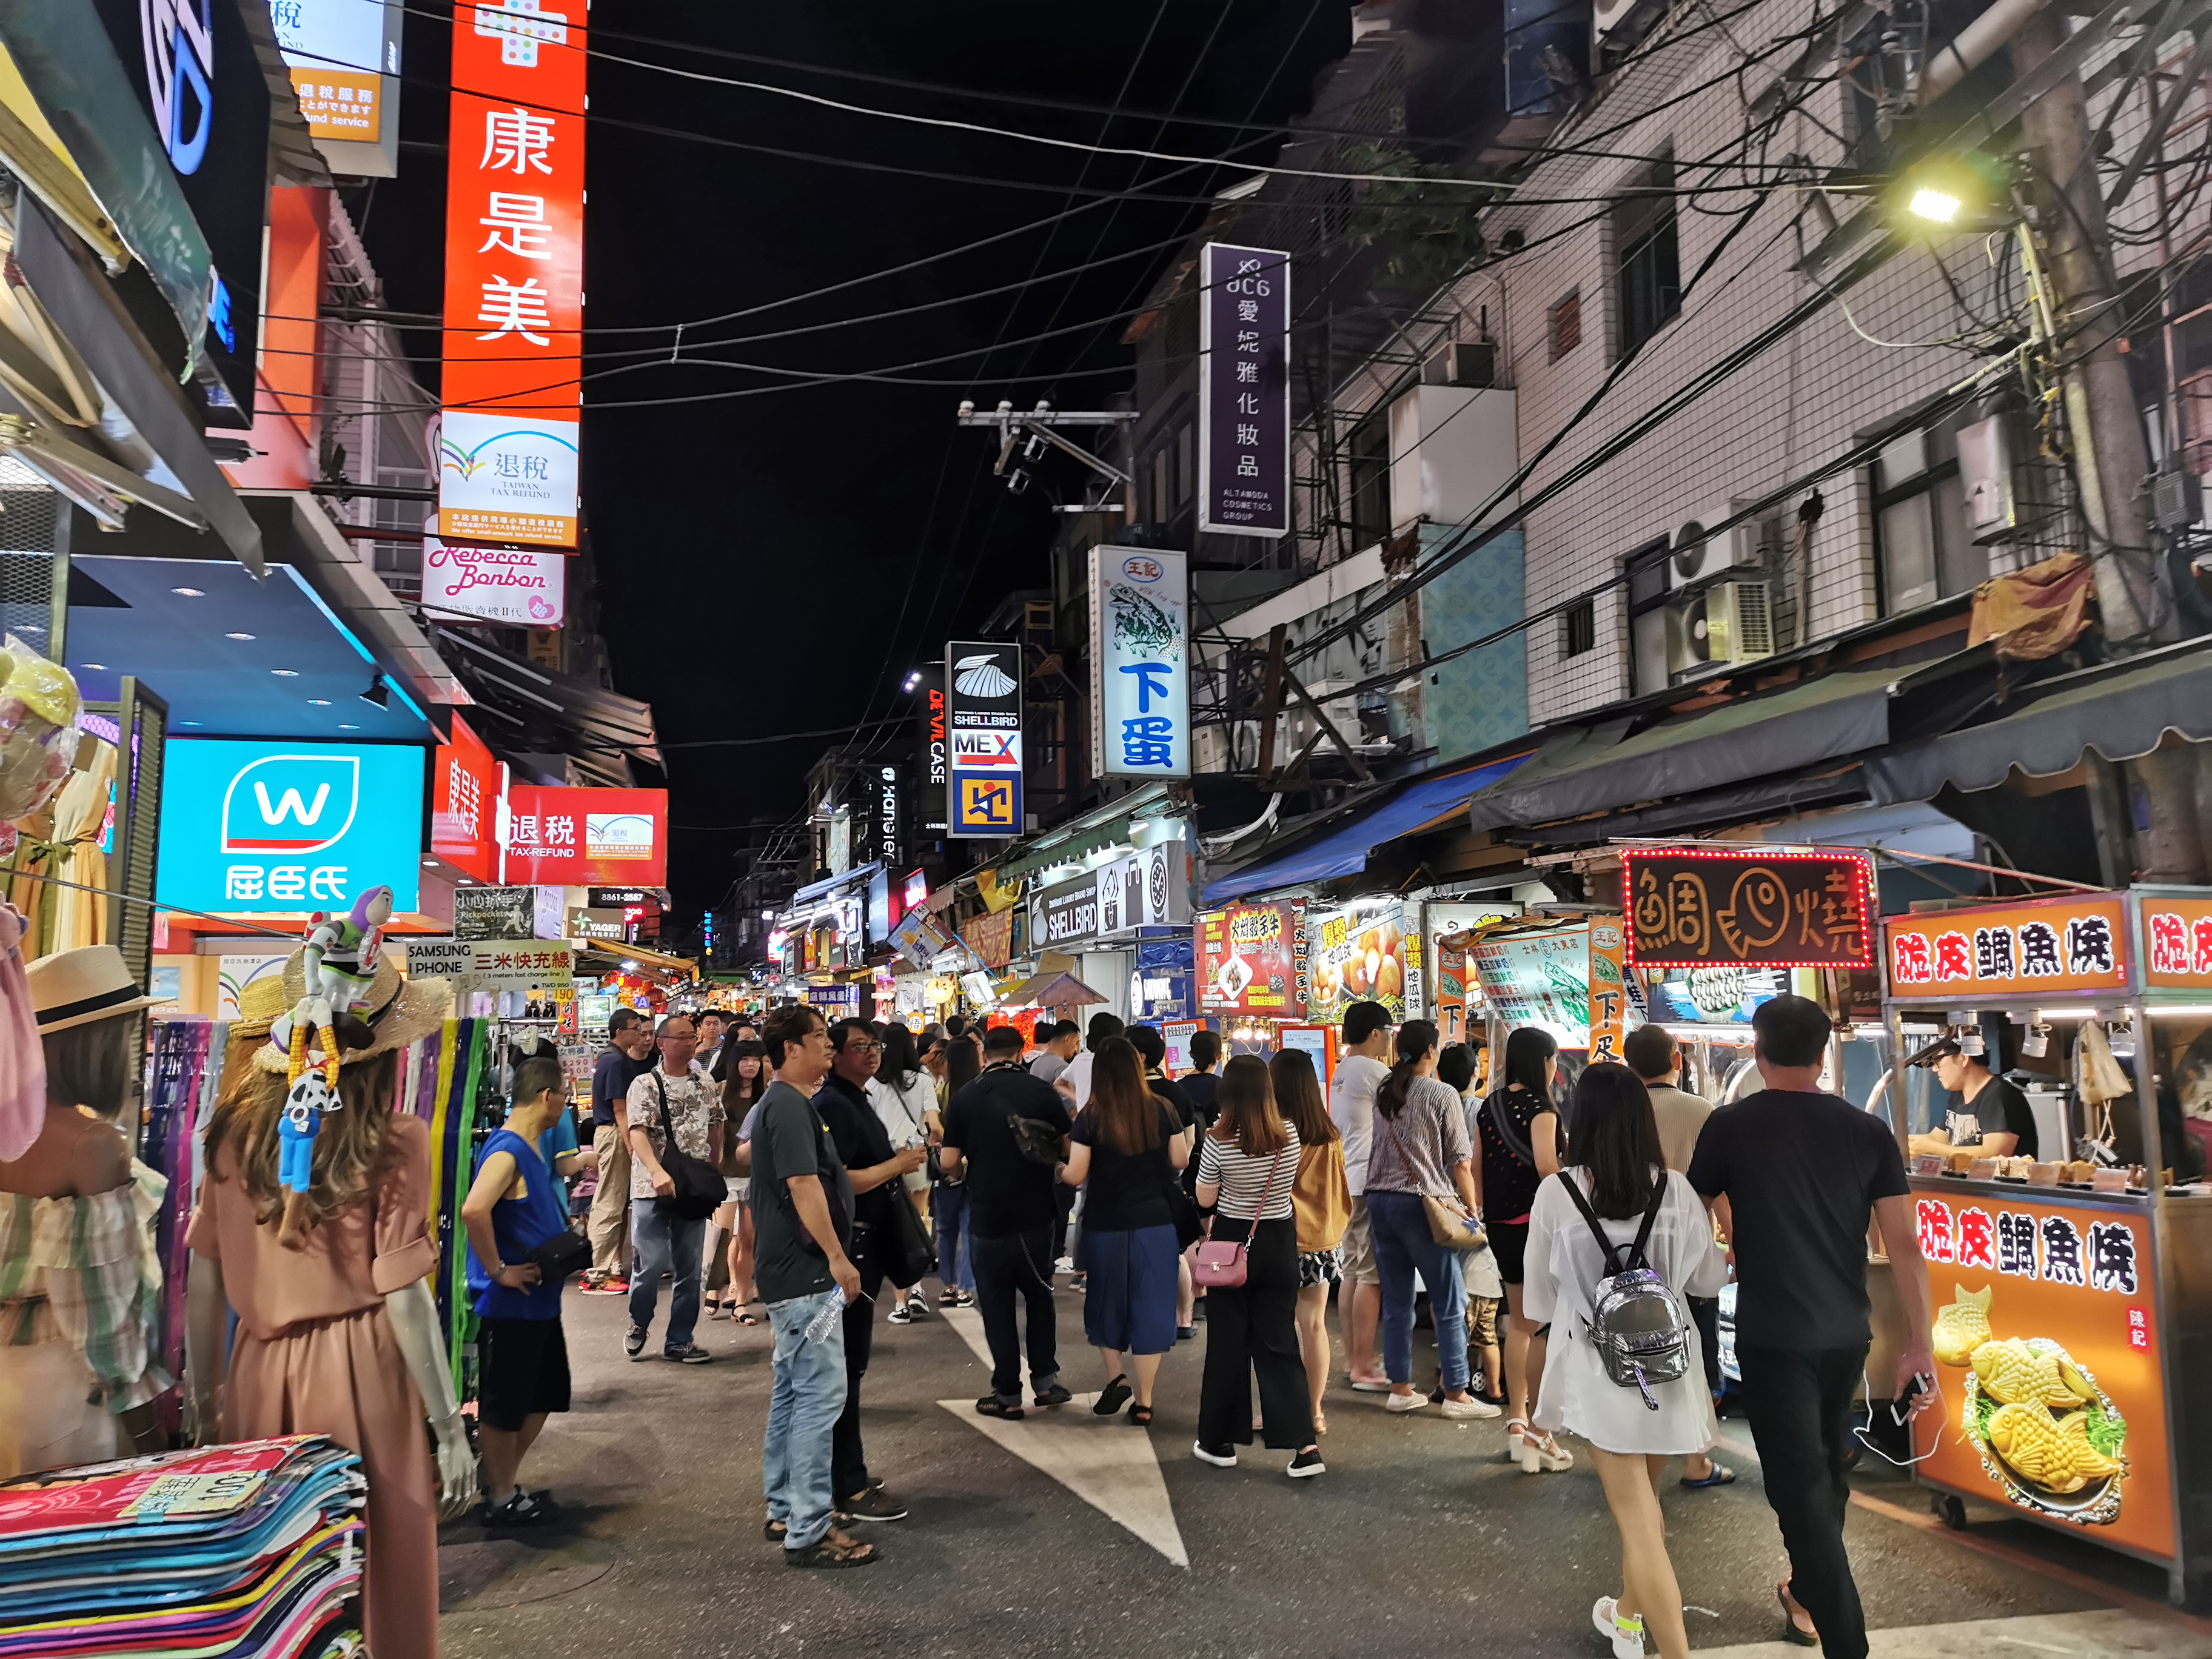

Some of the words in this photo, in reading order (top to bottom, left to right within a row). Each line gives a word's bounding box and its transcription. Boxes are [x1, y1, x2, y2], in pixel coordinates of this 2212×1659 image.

[332, 117, 369, 127] service
[475, 107, 555, 346] 康是美
[501, 481, 539, 490] TAIWAN
[490, 488, 510, 496] TAX
[512, 490, 550, 498] REFUND
[1222, 500, 1272, 511] COSMETICS
[1222, 511, 1254, 520] GROUP
[428, 547, 538, 568] Rebecca
[1127, 561, 1160, 577] 王記
[445, 564, 546, 596] Bonbon
[954, 716, 1018, 726] SHELLBIRD
[1119, 663, 1173, 768] 下蛋
[954, 733, 1017, 758] MEX
[447, 758, 480, 840] 康是美
[509, 847, 575, 857] TAX-REFUND
[225, 865, 348, 900] 屈臣氏
[602, 893, 643, 902] 8861-2587
[589, 923, 621, 932] YAGER
[1049, 902, 1097, 940] SHELLBIRD
[1595, 930, 1617, 942] 王記
[409, 945, 471, 957] SAMSUNG
[1893, 915, 2114, 984] 脆皮鯛魚燒
[416, 961, 463, 974] PHONE
[475, 951, 571, 970] 三米快充線
[562, 1059, 588, 1067] $290
[1915, 1199, 2137, 1295] 脆皮鯛魚燒
[2130, 1309, 2146, 1347] 陳記
